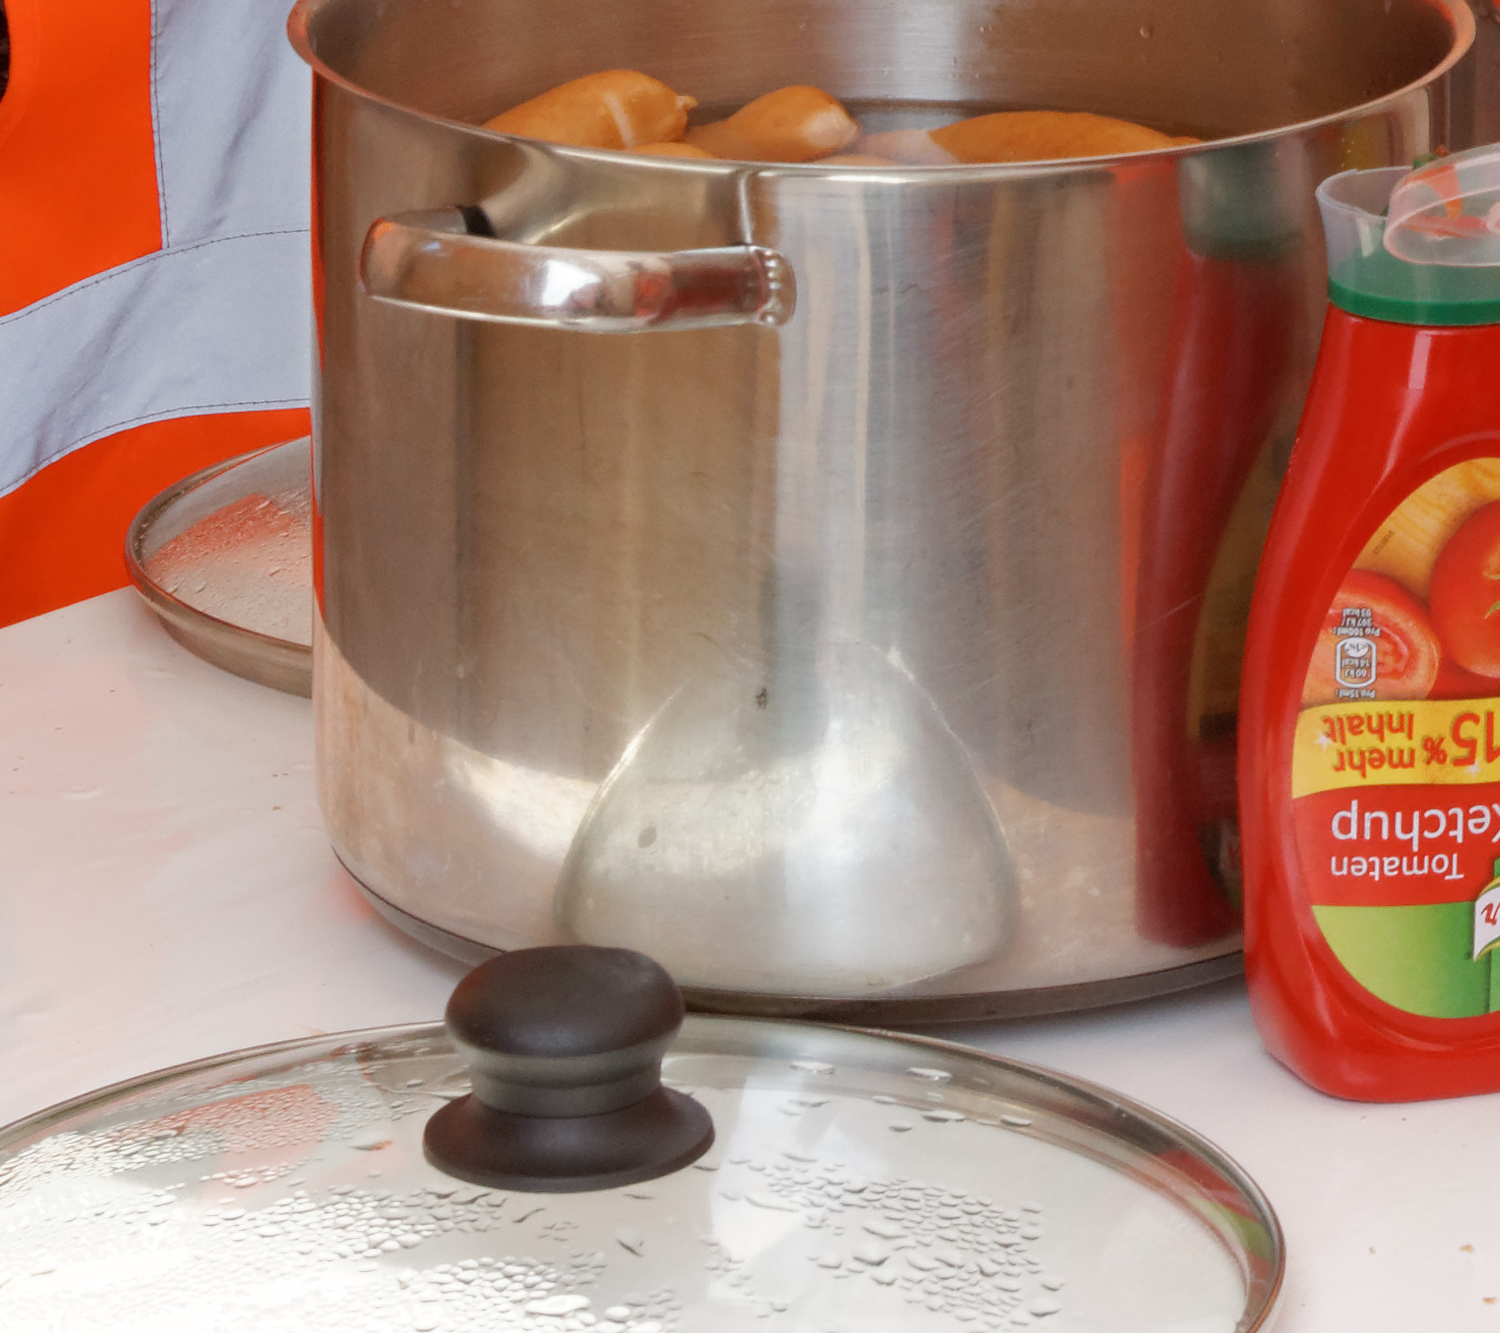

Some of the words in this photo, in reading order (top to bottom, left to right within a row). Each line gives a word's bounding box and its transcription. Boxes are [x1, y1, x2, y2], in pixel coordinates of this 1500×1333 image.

[1365, 628, 1380, 636] Pro
[1342, 658, 1359, 667] kcal
[1345, 668, 1355, 677] kJ
[1356, 668, 1366, 677] 60
[1361, 690, 1375, 698] Pro
[1323, 713, 1415, 746] Inhalt
[1332, 746, 1415, 778] mehr
[1330, 853, 1464, 880] Tomaten
